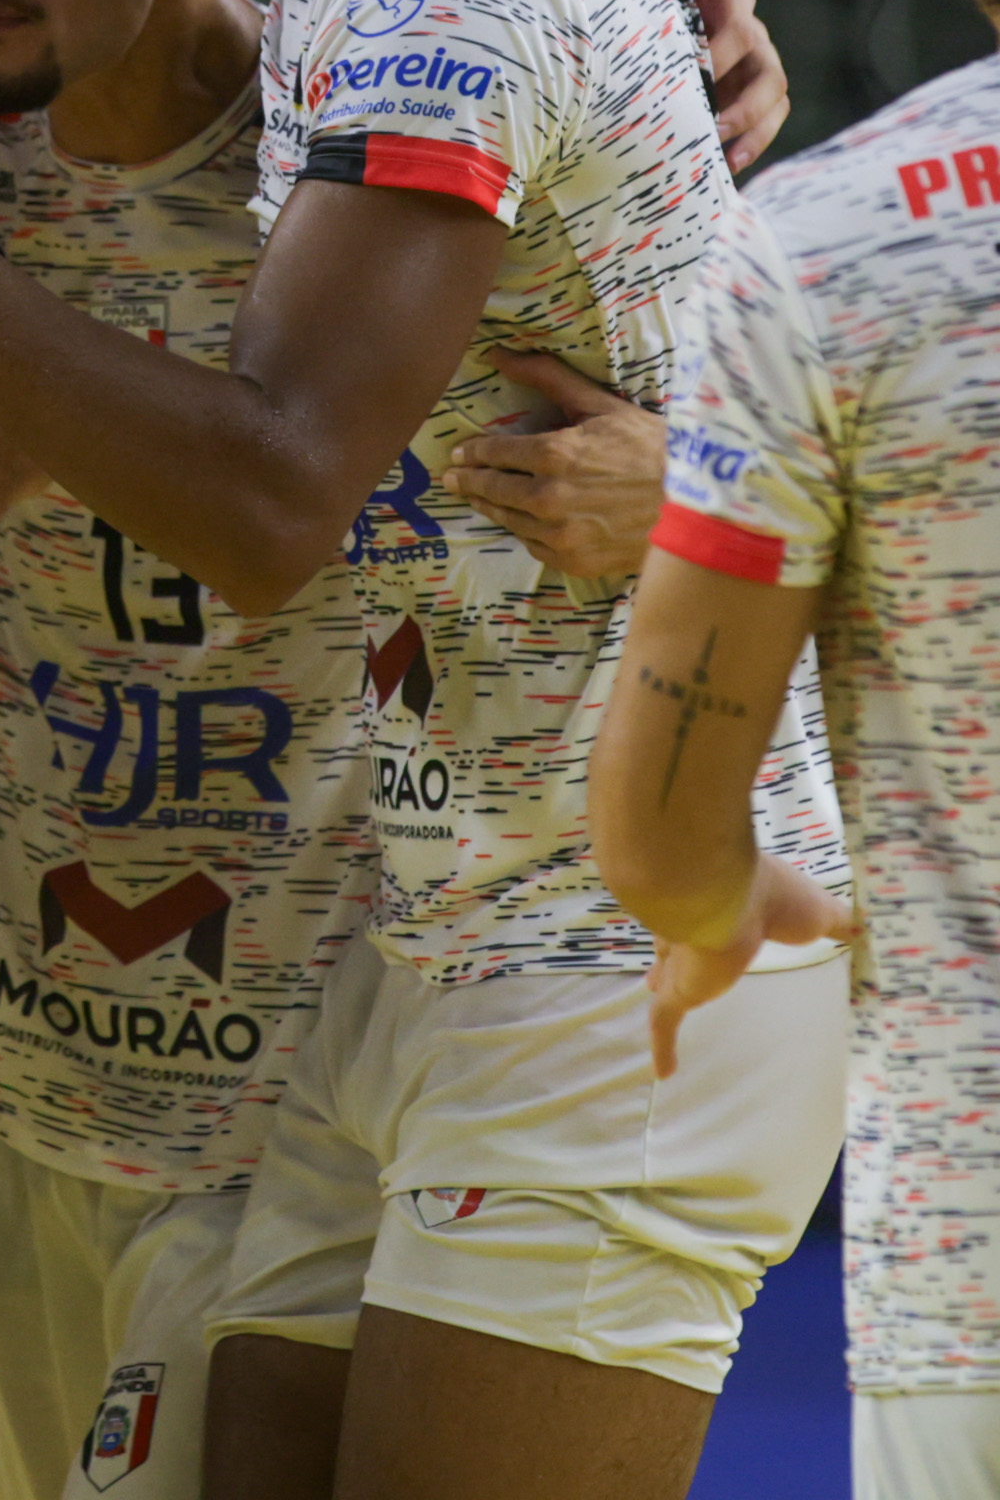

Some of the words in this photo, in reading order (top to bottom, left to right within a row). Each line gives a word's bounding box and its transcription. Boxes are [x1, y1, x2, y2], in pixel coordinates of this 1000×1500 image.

[325, 47, 493, 100] pereira
[400, 97, 456, 121] Saúde
[156, 808, 289, 833] SPORTS
